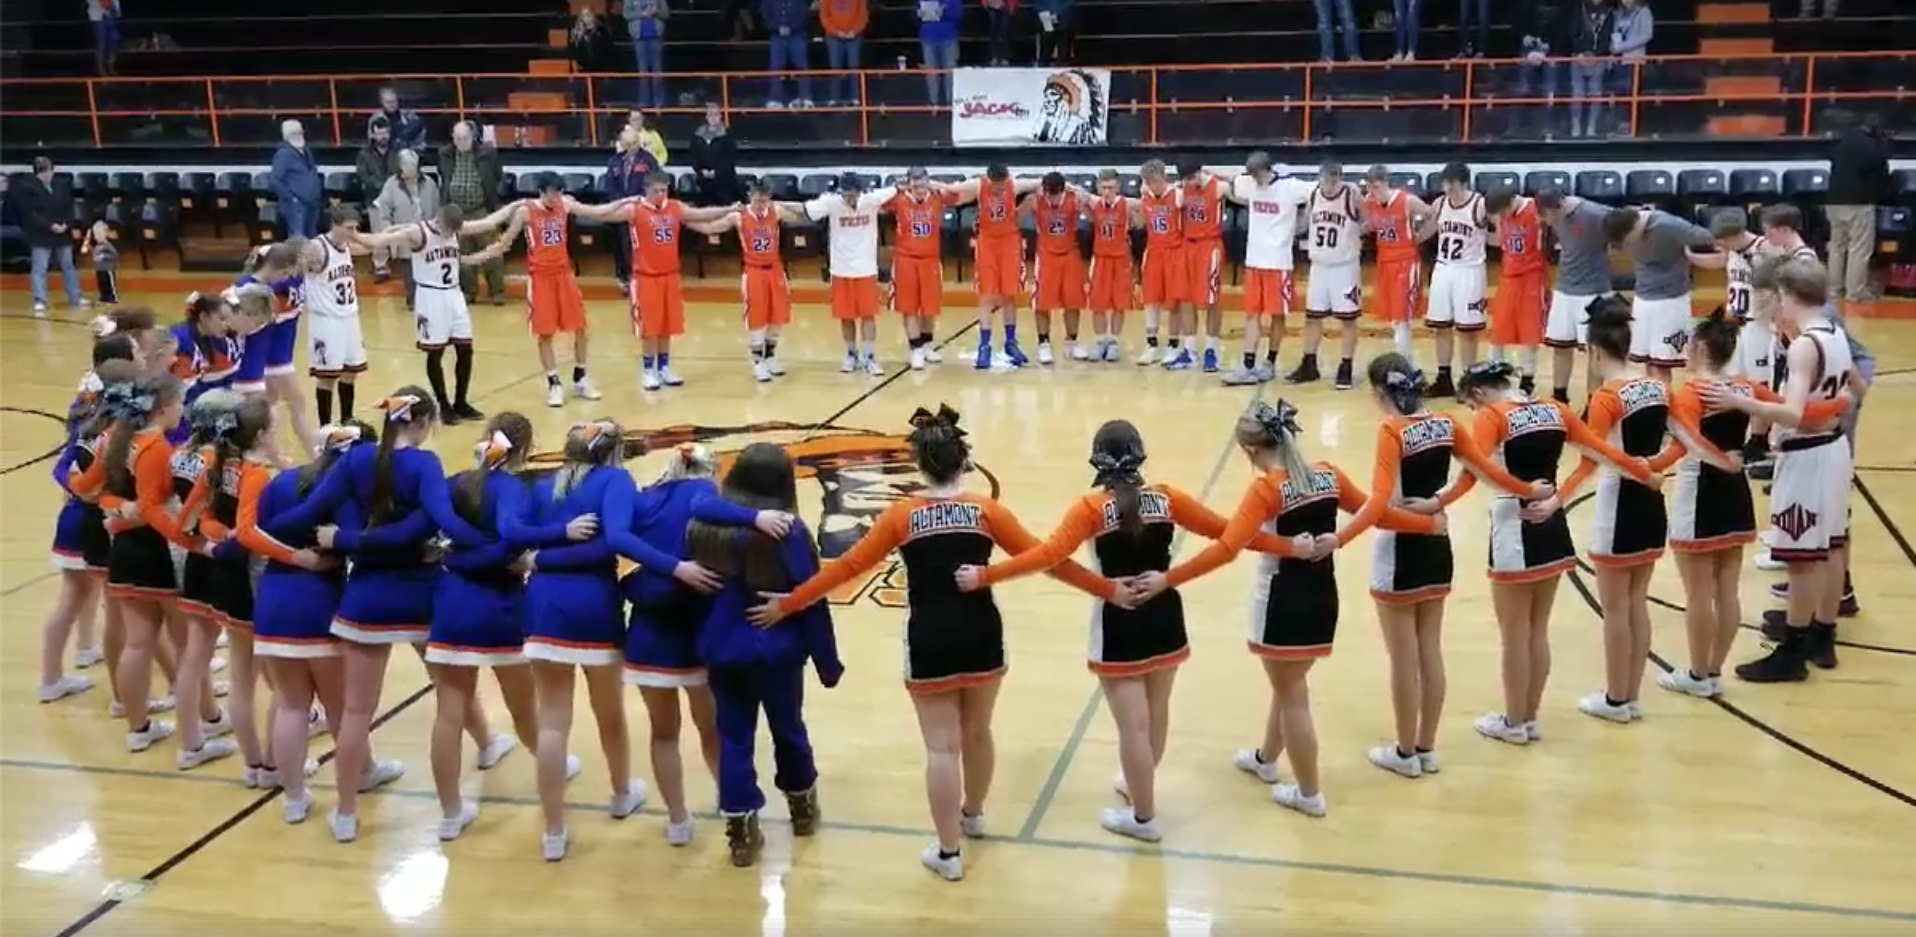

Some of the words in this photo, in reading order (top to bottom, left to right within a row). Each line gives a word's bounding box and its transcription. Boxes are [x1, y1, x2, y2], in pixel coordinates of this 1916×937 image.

[543, 229, 563, 245] 23
[654, 227, 673, 243] 55
[912, 222, 931, 237] 50
[1315, 226, 1338, 248] 50
[1441, 237, 1464, 260] 42
[441, 263, 453, 285] 2
[335, 281, 355, 305] 32
[910, 502, 981, 533] ALTAMONT
